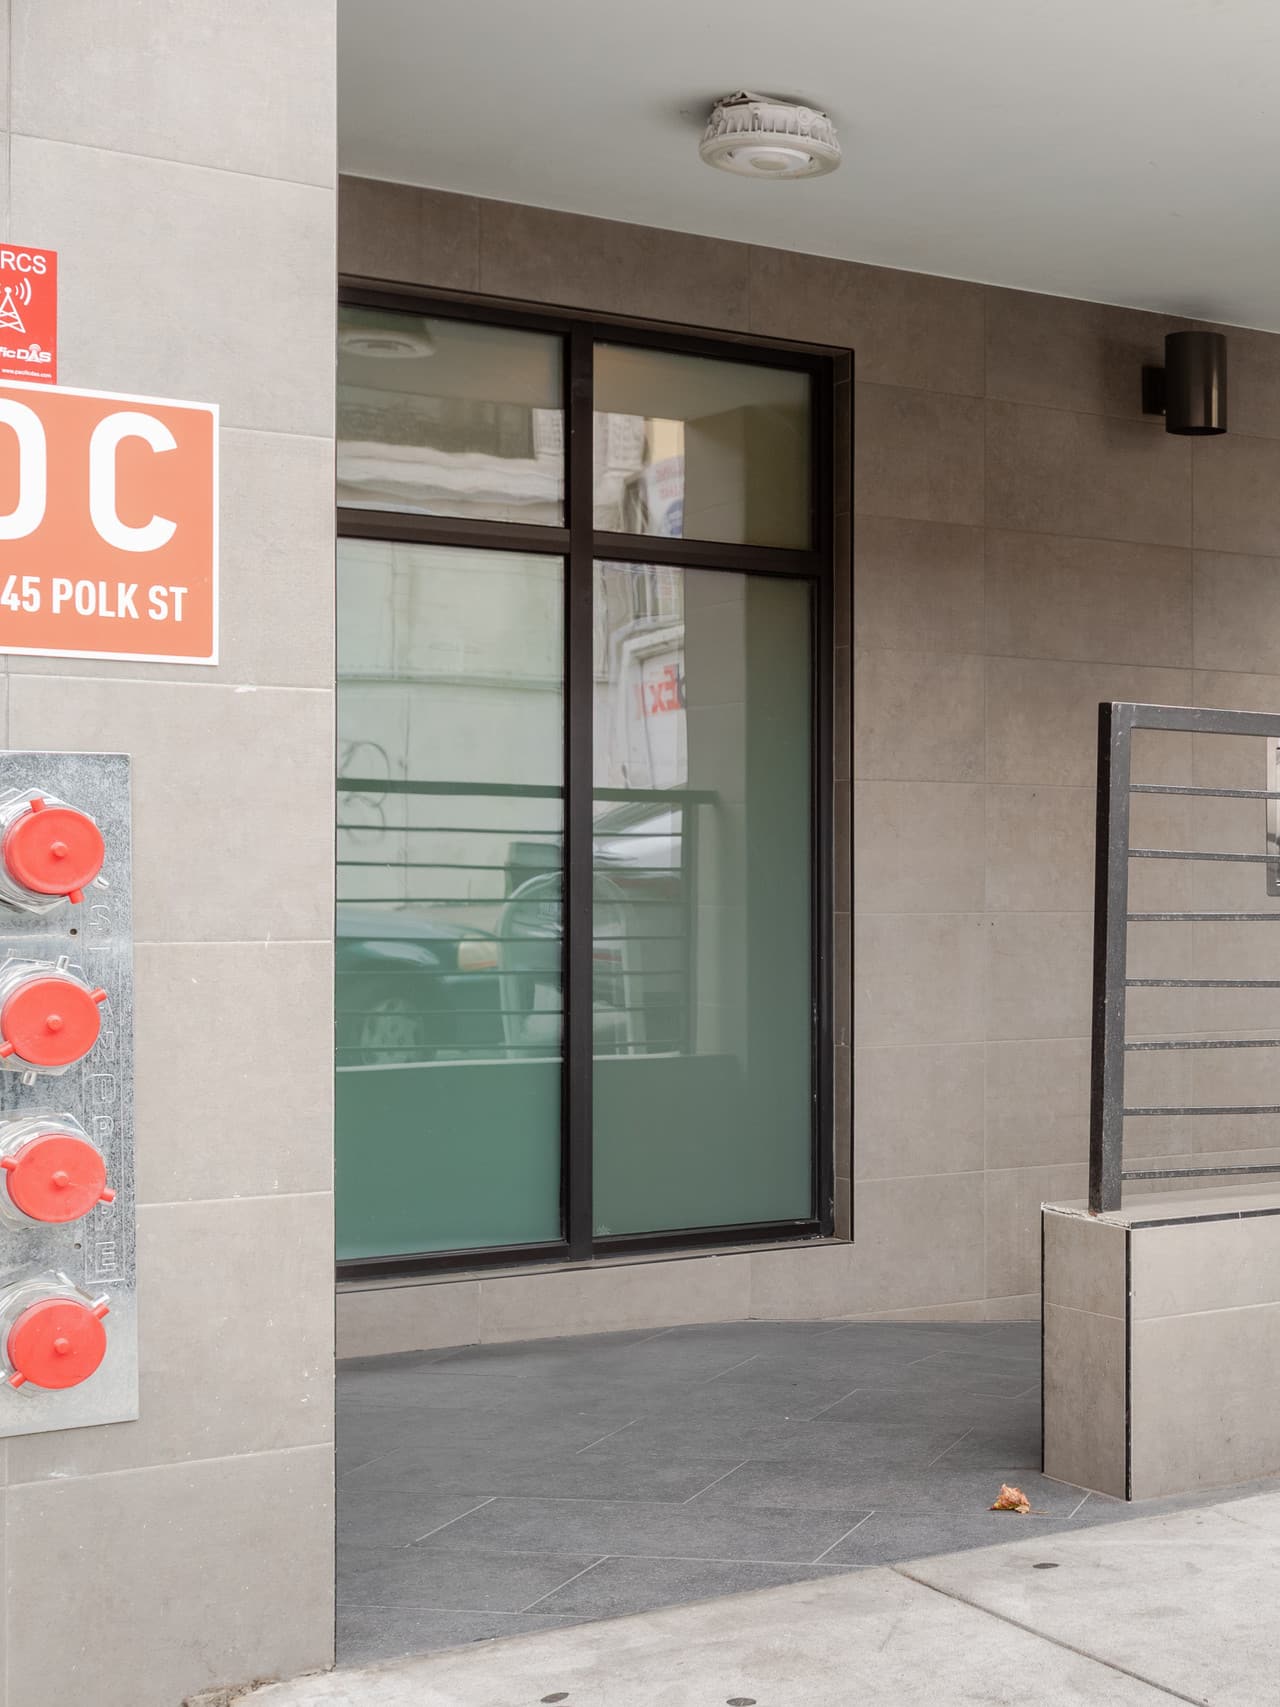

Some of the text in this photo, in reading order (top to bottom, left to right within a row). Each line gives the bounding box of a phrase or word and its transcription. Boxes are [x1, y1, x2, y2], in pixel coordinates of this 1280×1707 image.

[1, 250, 47, 275] RCS
[0, 574, 188, 622] 45 POLK ST
